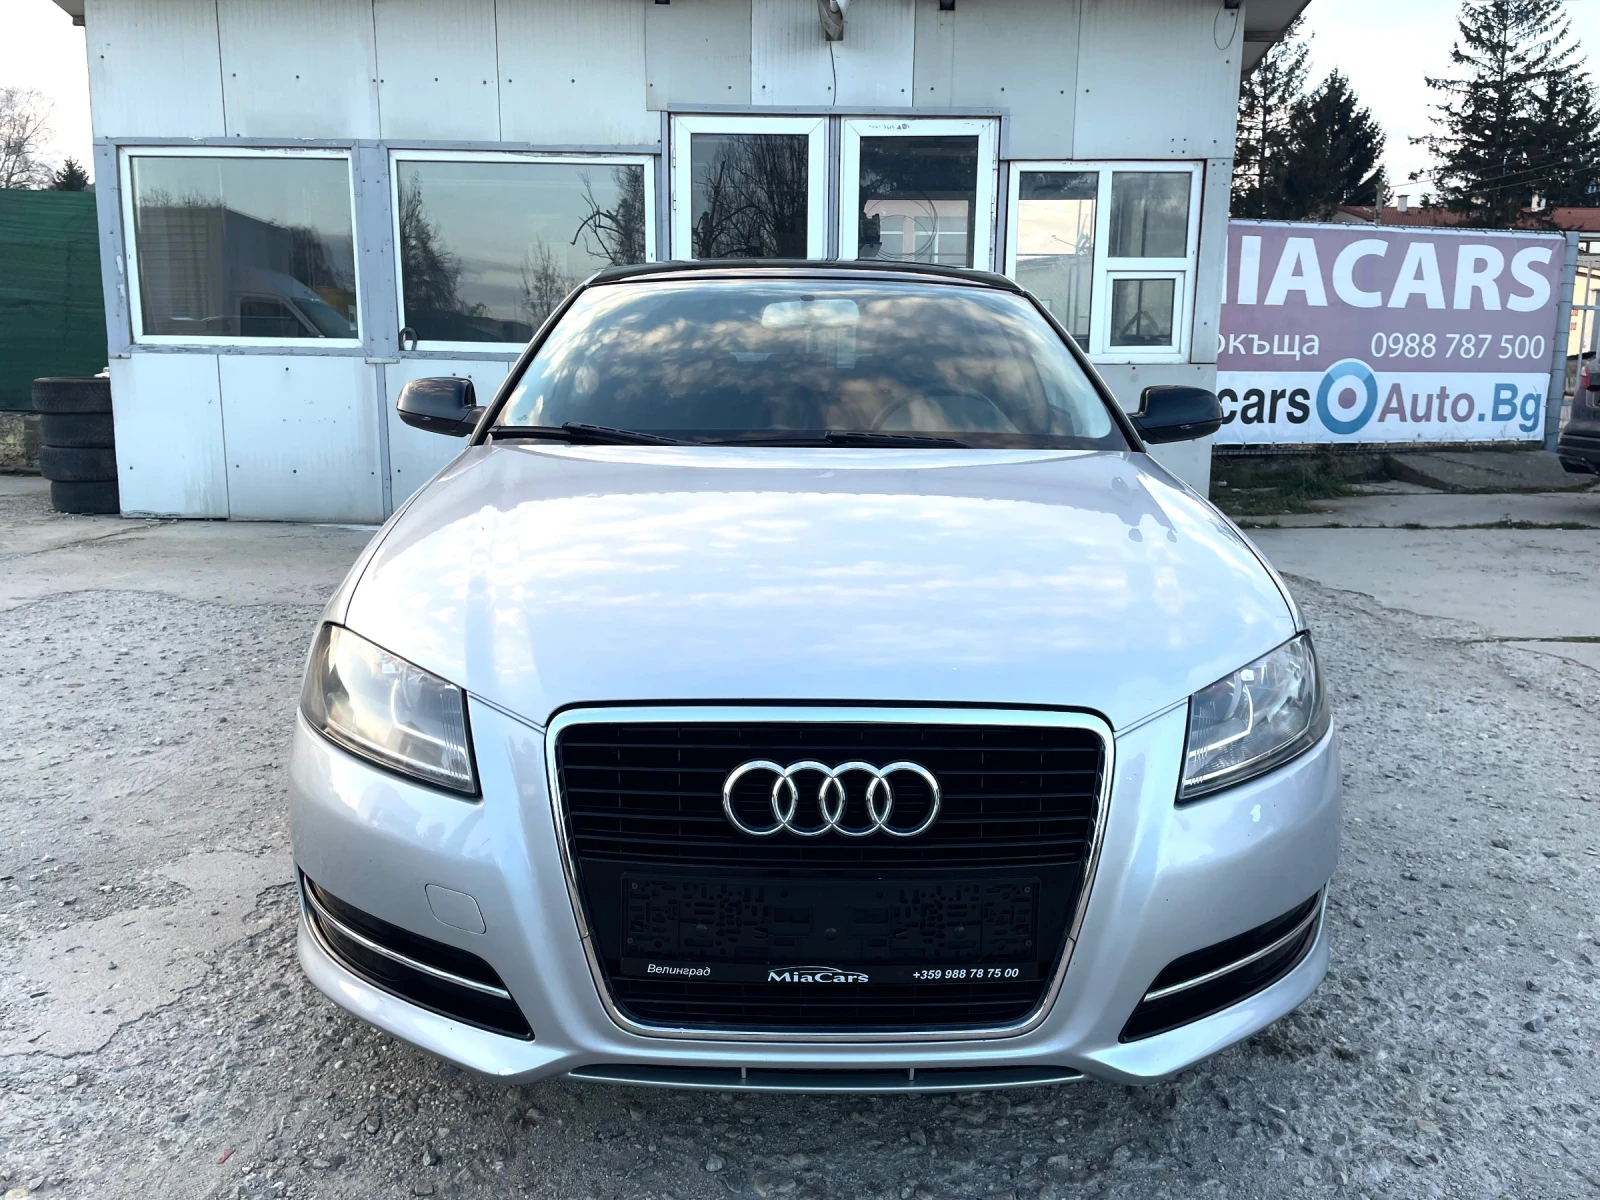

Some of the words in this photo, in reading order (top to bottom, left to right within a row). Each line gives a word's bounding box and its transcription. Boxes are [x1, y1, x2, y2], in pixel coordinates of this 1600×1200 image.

[1221, 235, 1553, 312] IACARS
[1371, 332, 1437, 359] 0988
[1445, 333, 1493, 359] 787
[1498, 334, 1545, 360] 500
[1376, 382, 1542, 433] Auto.Bg
[647, 963, 711, 978] Велинград
[767, 971, 869, 983] MiaCars
[912, 969, 942, 980] +359
[944, 969, 967, 979] 988
[969, 968, 984, 979] 78
[987, 968, 1002, 978] 75
[1004, 968, 1020, 978] 00
